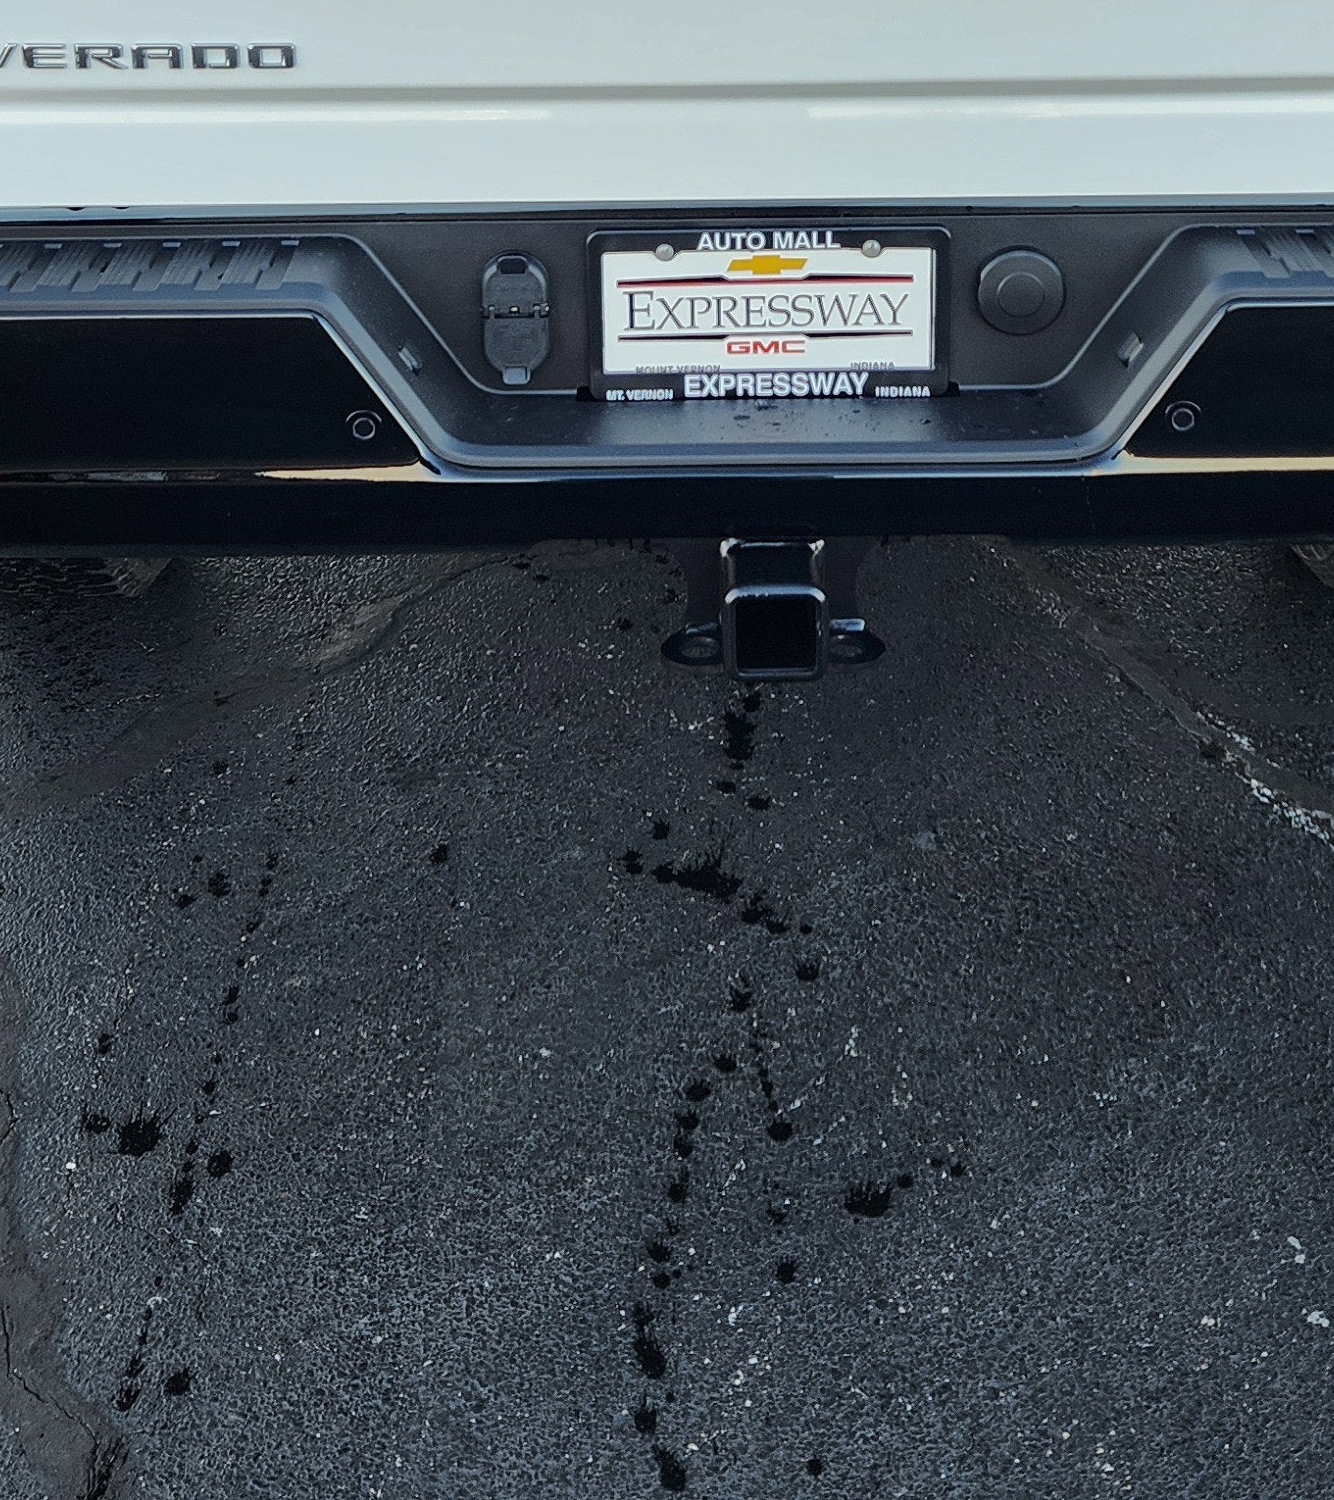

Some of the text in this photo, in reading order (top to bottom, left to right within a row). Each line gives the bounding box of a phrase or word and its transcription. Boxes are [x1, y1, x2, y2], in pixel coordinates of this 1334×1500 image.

[696, 229, 842, 251] AUTO MALL
[622, 290, 910, 331] EXPRESSWAY
[726, 339, 806, 354] GMC
[635, 365, 721, 374] MOUNT VERNON
[850, 361, 895, 370] INDIANA
[684, 372, 869, 398] EXPRESSWAY
[875, 385, 931, 398] INDIANA
[626, 388, 674, 401] VERNON
